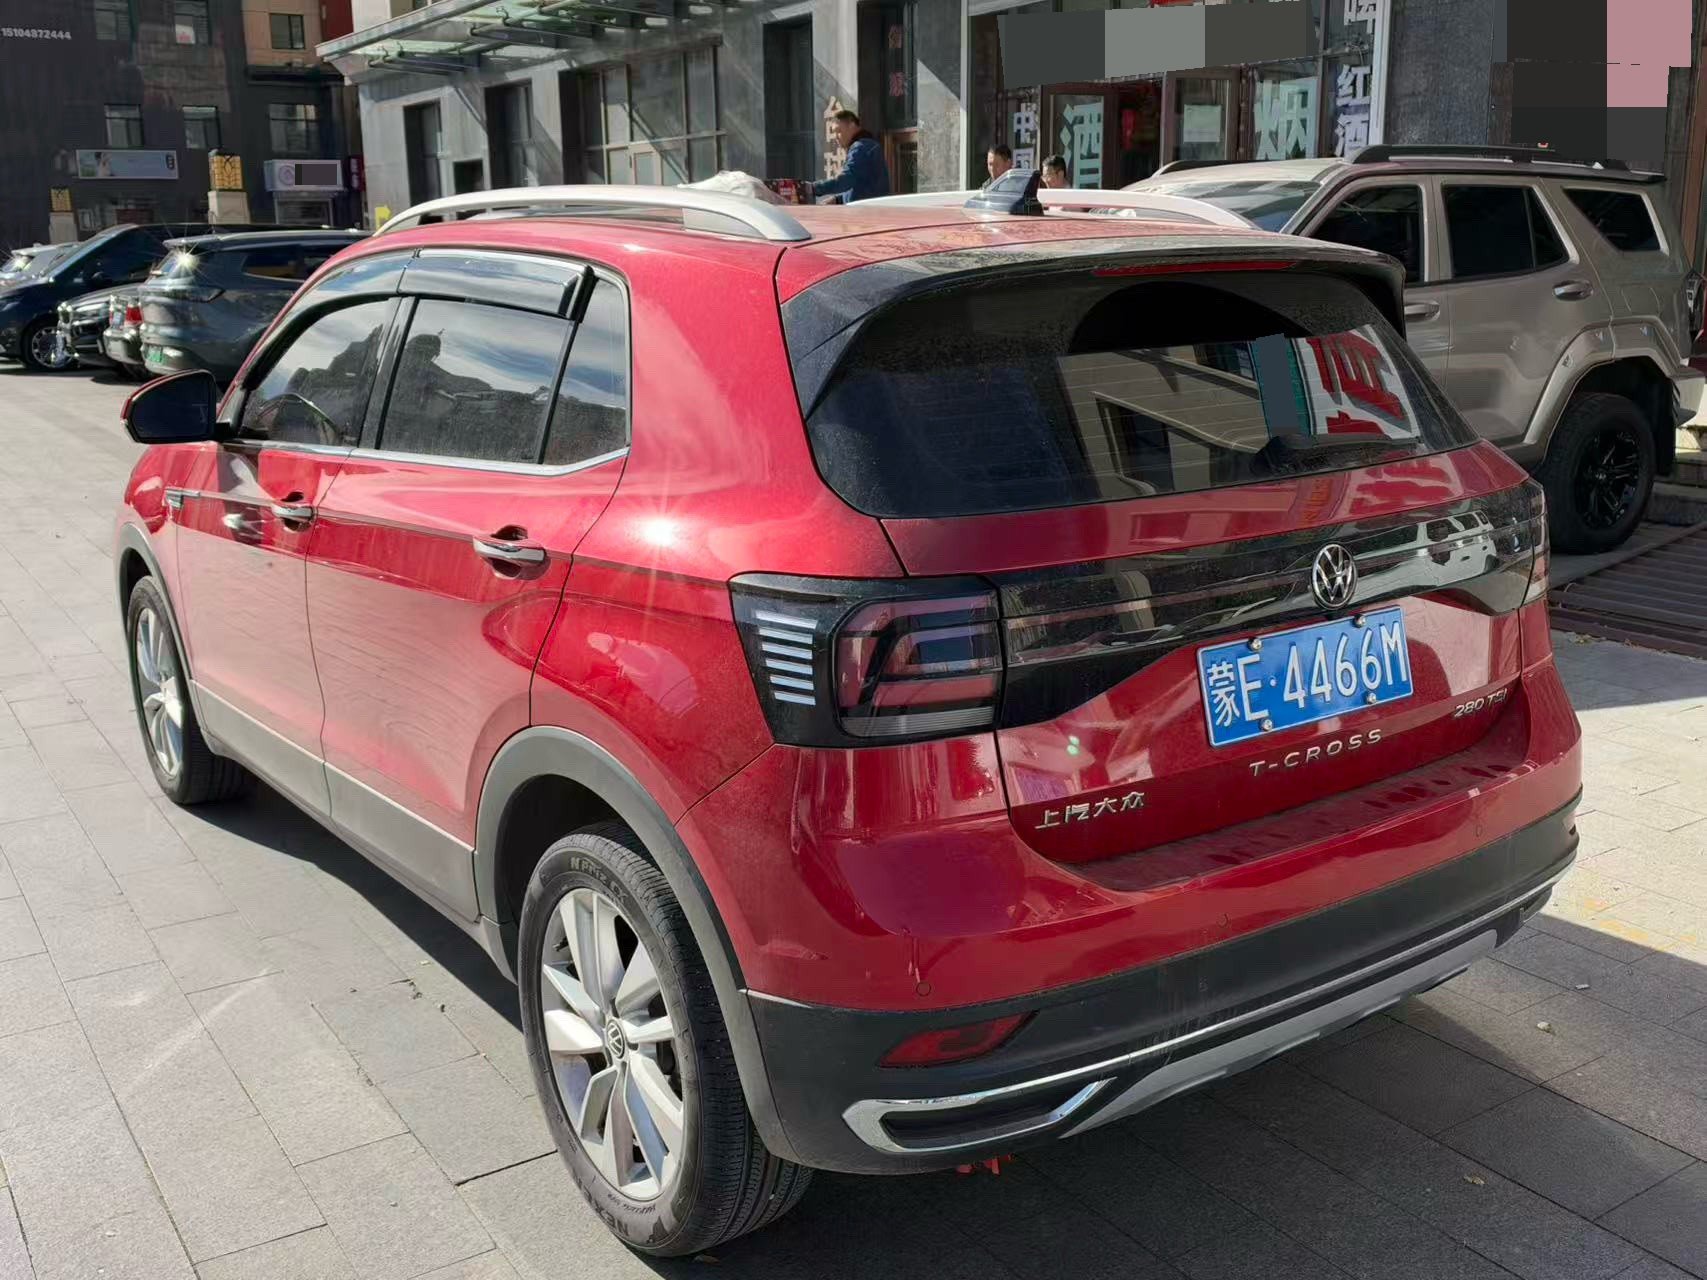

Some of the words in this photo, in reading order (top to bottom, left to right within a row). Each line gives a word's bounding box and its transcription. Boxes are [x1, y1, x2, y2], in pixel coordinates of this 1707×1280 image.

[2, 27, 72, 40] 15104872444
[1253, 76, 1318, 160] 烟
[1334, 64, 1371, 163] 红酒
[1060, 103, 1103, 189] 酒
[1454, 697, 1485, 718] 280
[1249, 728, 1382, 777] T-CROSS
[1034, 791, 1145, 829] 上汽大众
